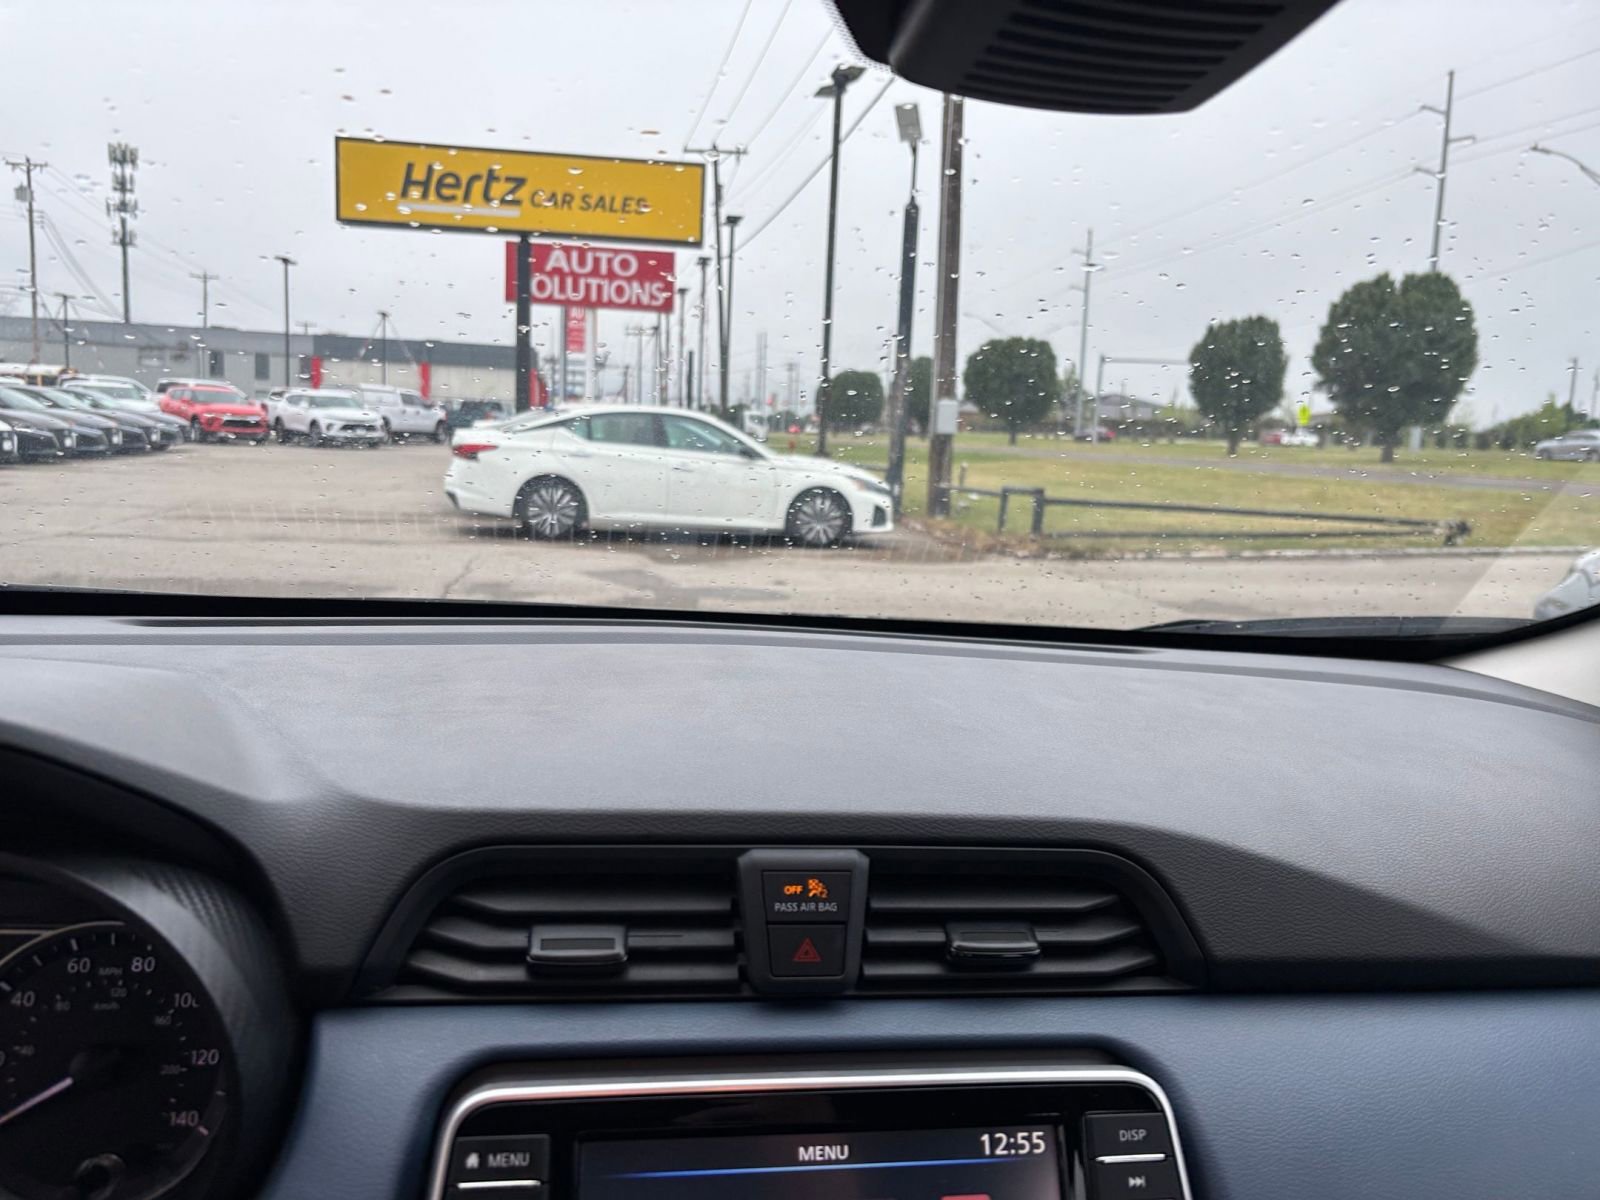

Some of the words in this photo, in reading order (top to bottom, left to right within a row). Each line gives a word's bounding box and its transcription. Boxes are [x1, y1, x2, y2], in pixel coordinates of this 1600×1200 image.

[400, 161, 528, 207] Hertz
[530, 189, 573, 209] CAR
[579, 192, 649, 215] SALES
[545, 250, 639, 277] AUTO
[530, 275, 666, 307] OLUTIONS
[784, 885, 804, 895] OFF
[774, 902, 798, 912] PASS
[800, 902, 816, 912] AIR
[818, 902, 838, 912] BAG
[67, 957, 91, 974] 60
[131, 956, 156, 973] 80
[10, 991, 36, 1008] 40
[191, 1048, 220, 1065] 120
[169, 1110, 199, 1127] 140
[979, 1131, 1046, 1156] 12:55
[1119, 1129, 1147, 1142] DISP
[487, 1152, 530, 1168] MENU
[798, 1144, 850, 1162] MENU
